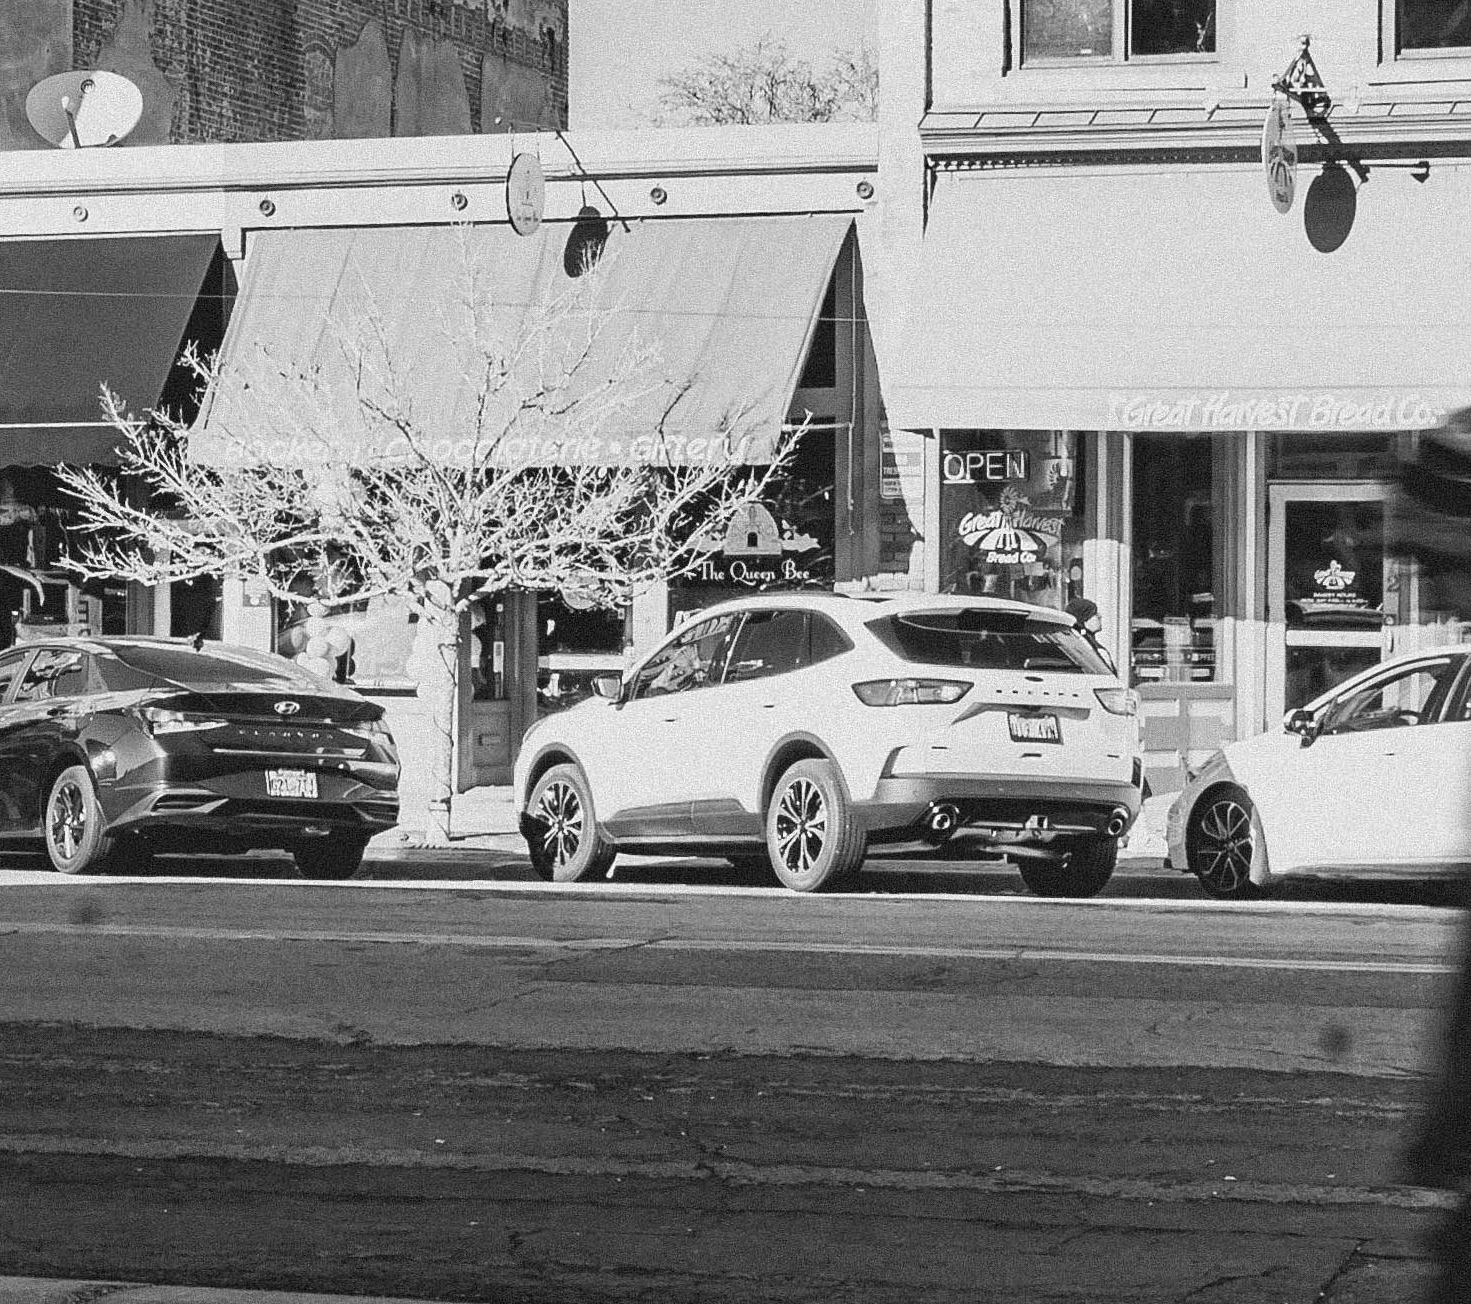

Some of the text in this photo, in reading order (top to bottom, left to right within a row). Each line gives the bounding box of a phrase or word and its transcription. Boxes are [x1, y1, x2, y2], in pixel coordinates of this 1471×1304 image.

[1121, 395, 1201, 427] Great
[1202, 391, 1309, 427] Harvest
[1310, 394, 1394, 427] Bread
[943, 452, 1025, 480] OPEN
[958, 508, 1065, 536] Great Harvest
[700, 559, 810, 586] The Queen Bee
